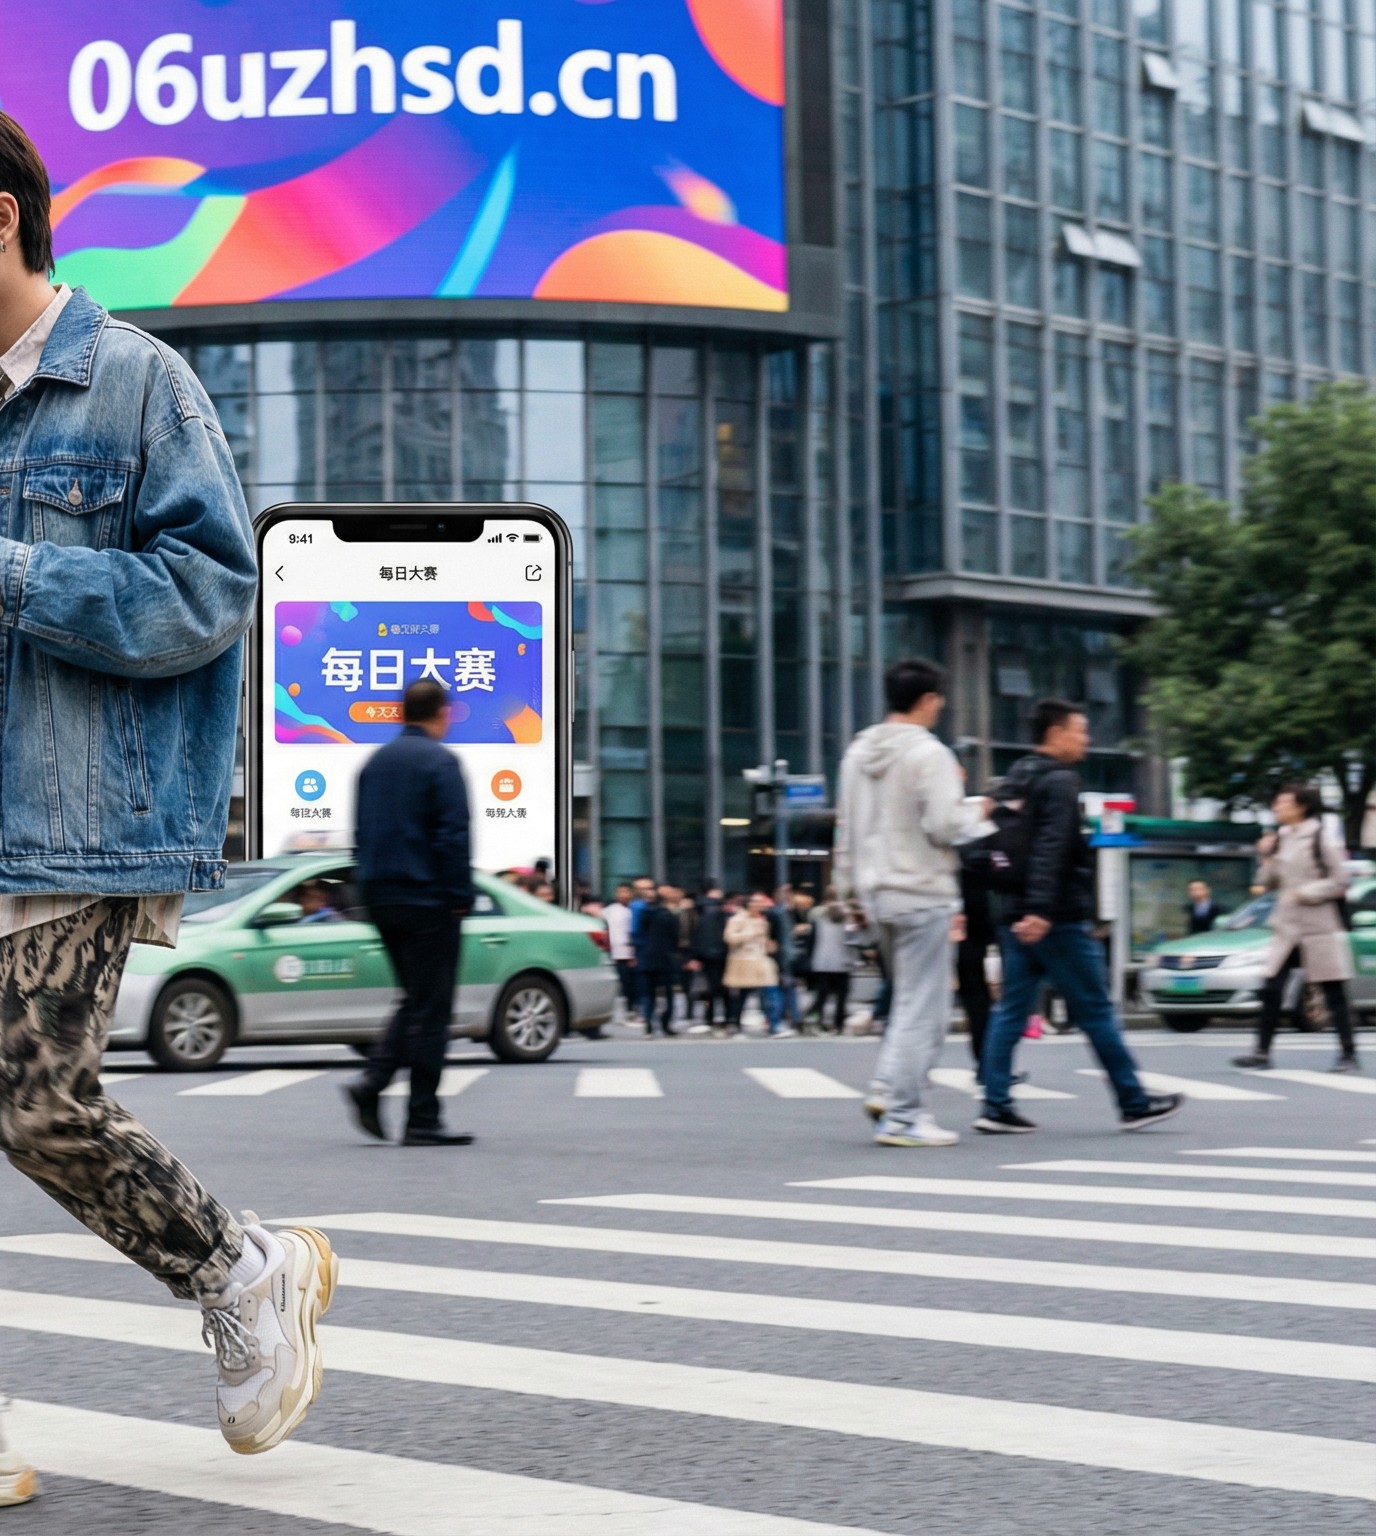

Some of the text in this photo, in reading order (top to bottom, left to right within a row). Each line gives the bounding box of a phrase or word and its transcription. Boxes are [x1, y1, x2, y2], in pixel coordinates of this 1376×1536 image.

[68, 19, 677, 132] 06uzhsd.cn
[288, 533, 314, 545] 9:41
[379, 565, 438, 581] 每日大赛
[321, 647, 497, 693] 每日大赛
